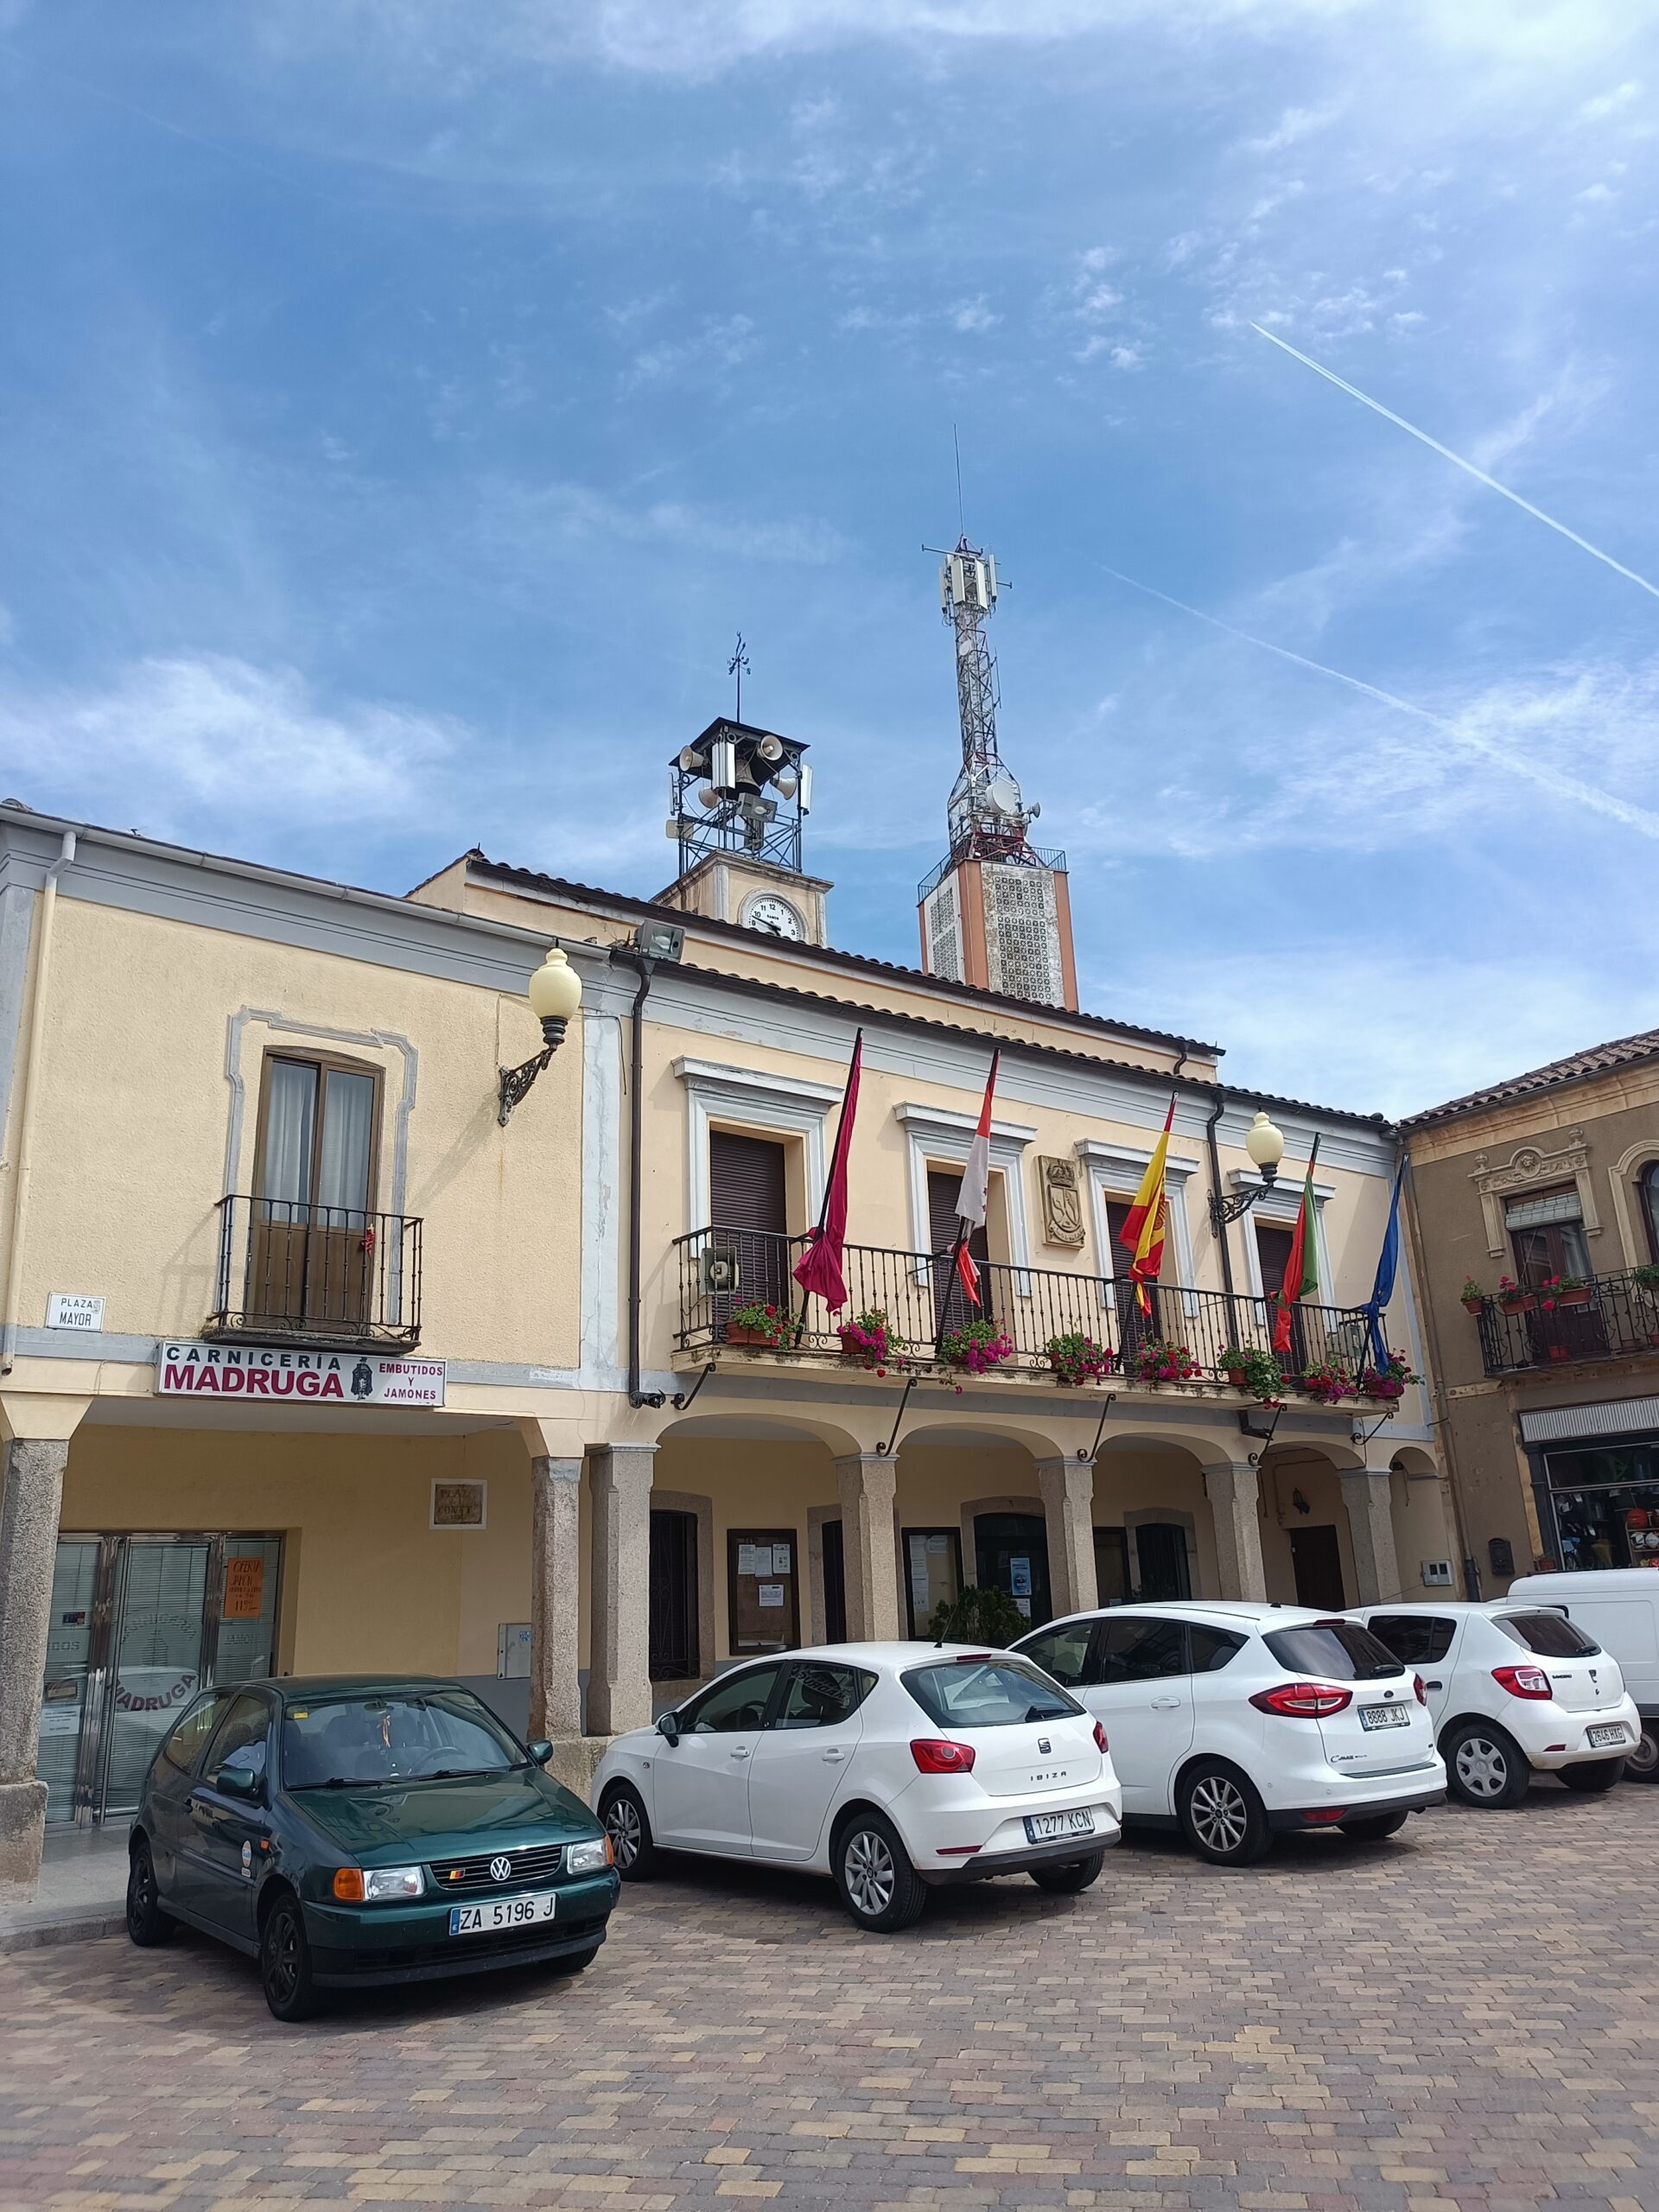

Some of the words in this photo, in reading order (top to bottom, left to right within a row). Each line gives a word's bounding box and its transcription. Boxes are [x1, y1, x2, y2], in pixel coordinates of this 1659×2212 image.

[60, 1298, 92, 1309] PLAZA
[59, 1312, 92, 1326] MAYOR
[166, 1346, 341, 1370] CARNICERÍA
[378, 1363, 443, 1376] EMBUTIDOS
[163, 1363, 345, 1398] MADRUGA
[408, 1376, 415, 1387] Y
[384, 1388, 436, 1400] JAMONES
[1366, 1709, 1388, 1724] 8888
[1389, 1707, 1405, 1722] JKJ
[1592, 1729, 1610, 1743] 2646
[1608, 1727, 1623, 1740] HXG
[1031, 1771, 1066, 1781] IBIZA
[1036, 1815, 1064, 1834] 1277
[1068, 1810, 1091, 1829] KCN
[460, 1908, 482, 1930] ZA
[493, 1901, 535, 1925] 5196
[543, 1897, 553, 1916] J
